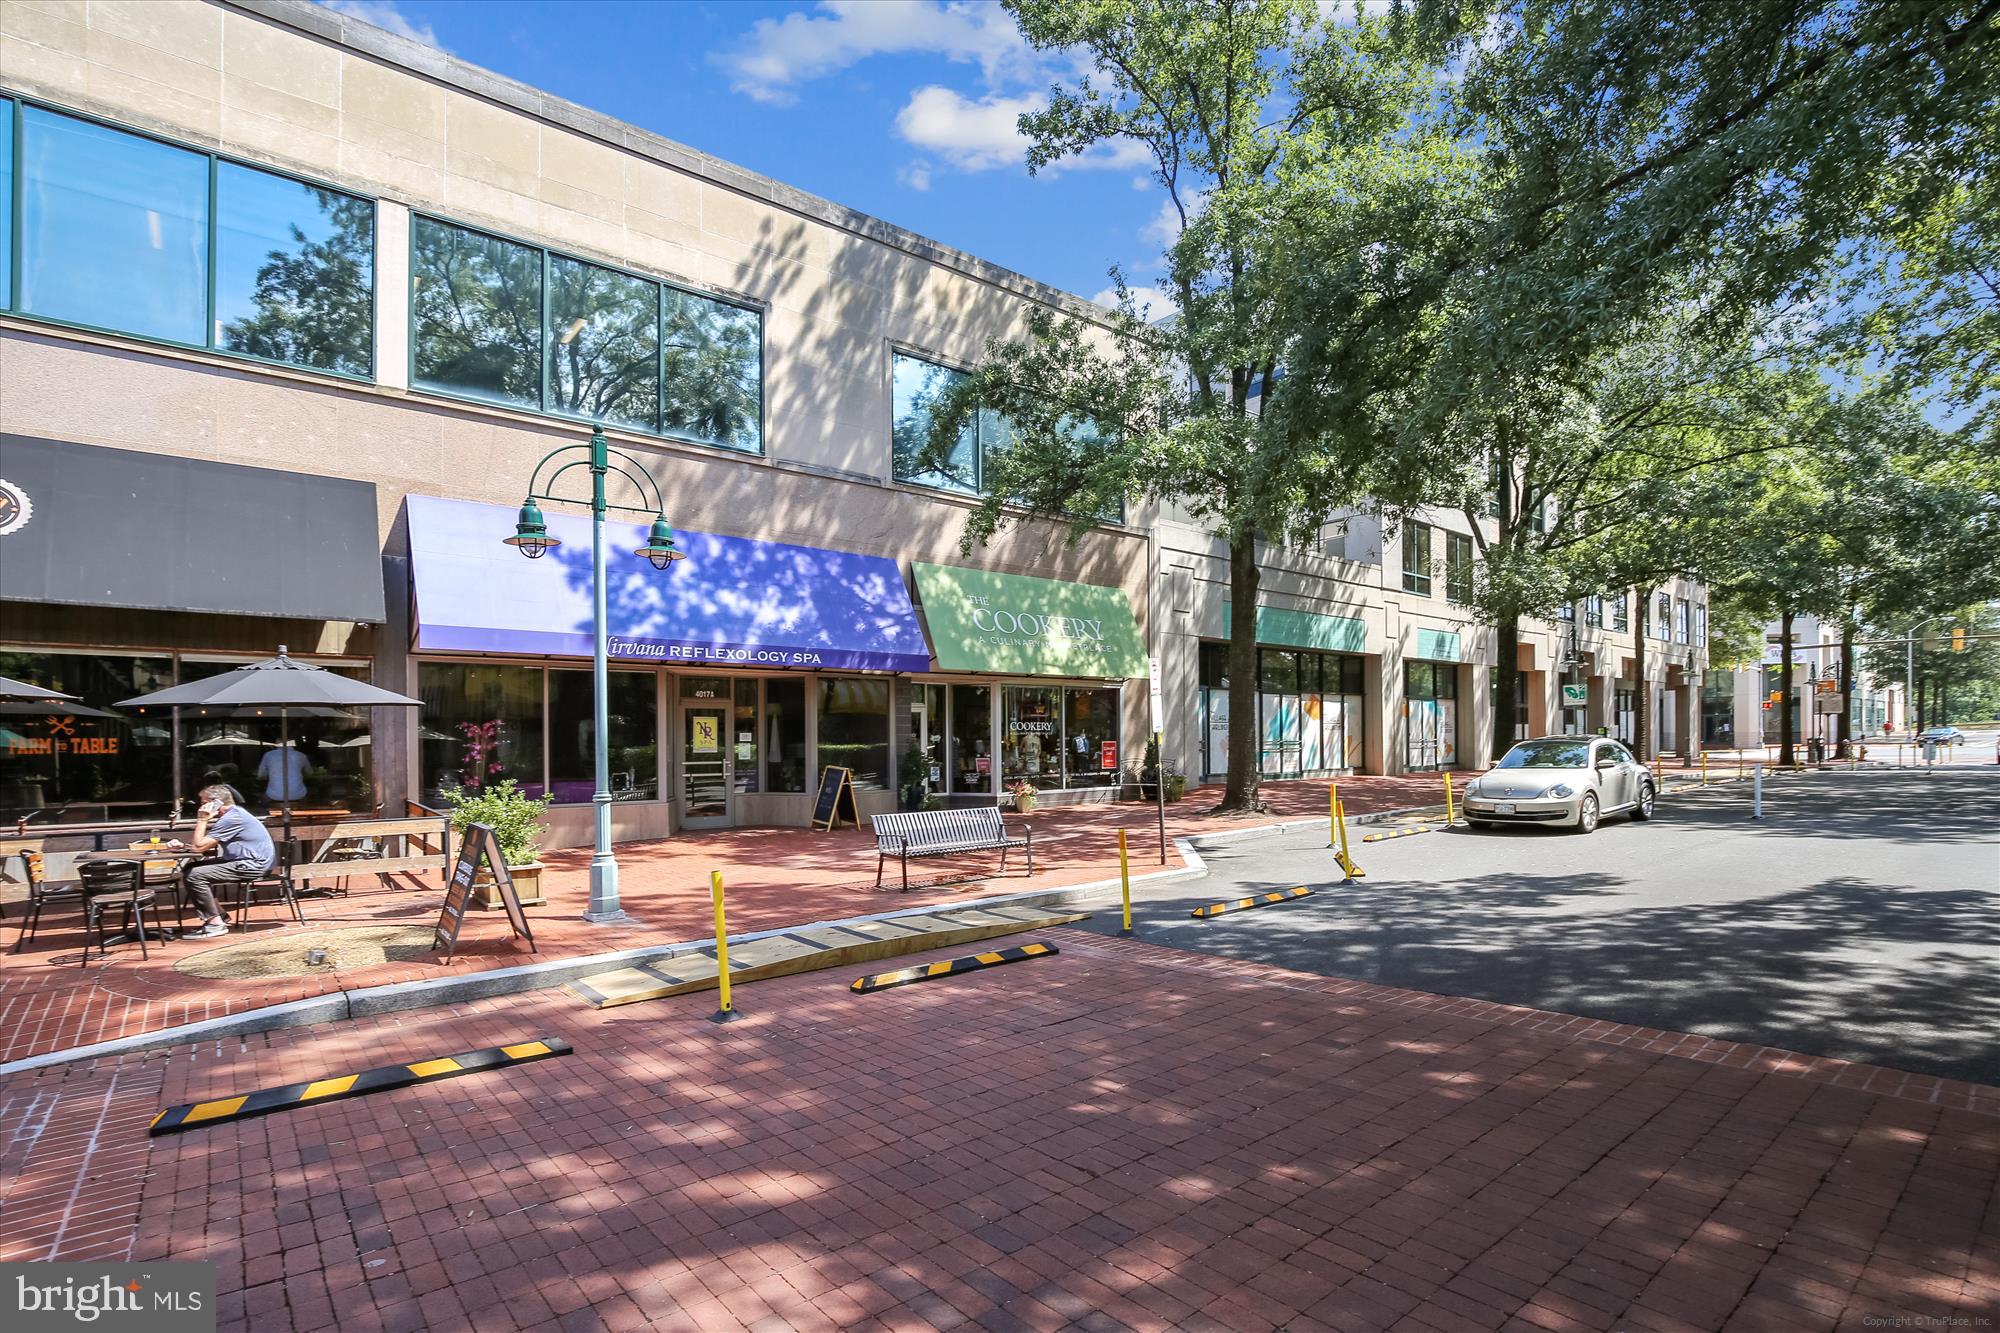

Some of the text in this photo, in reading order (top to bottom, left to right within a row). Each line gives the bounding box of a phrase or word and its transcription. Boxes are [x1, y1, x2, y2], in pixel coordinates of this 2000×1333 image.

[967, 595, 990, 606] THE
[973, 608, 1104, 641] COOKERY
[978, 636, 986, 644] A
[991, 636, 1040, 648] CULINARY
[669, 646, 788, 662] REFLEXOLOGY
[793, 653, 821, 664] SPA
[695, 690, 715, 698] 4017A
[1010, 722, 1053, 731] COOKERY
[9, 738, 52, 754] FARM
[70, 738, 119, 754] TABLE
